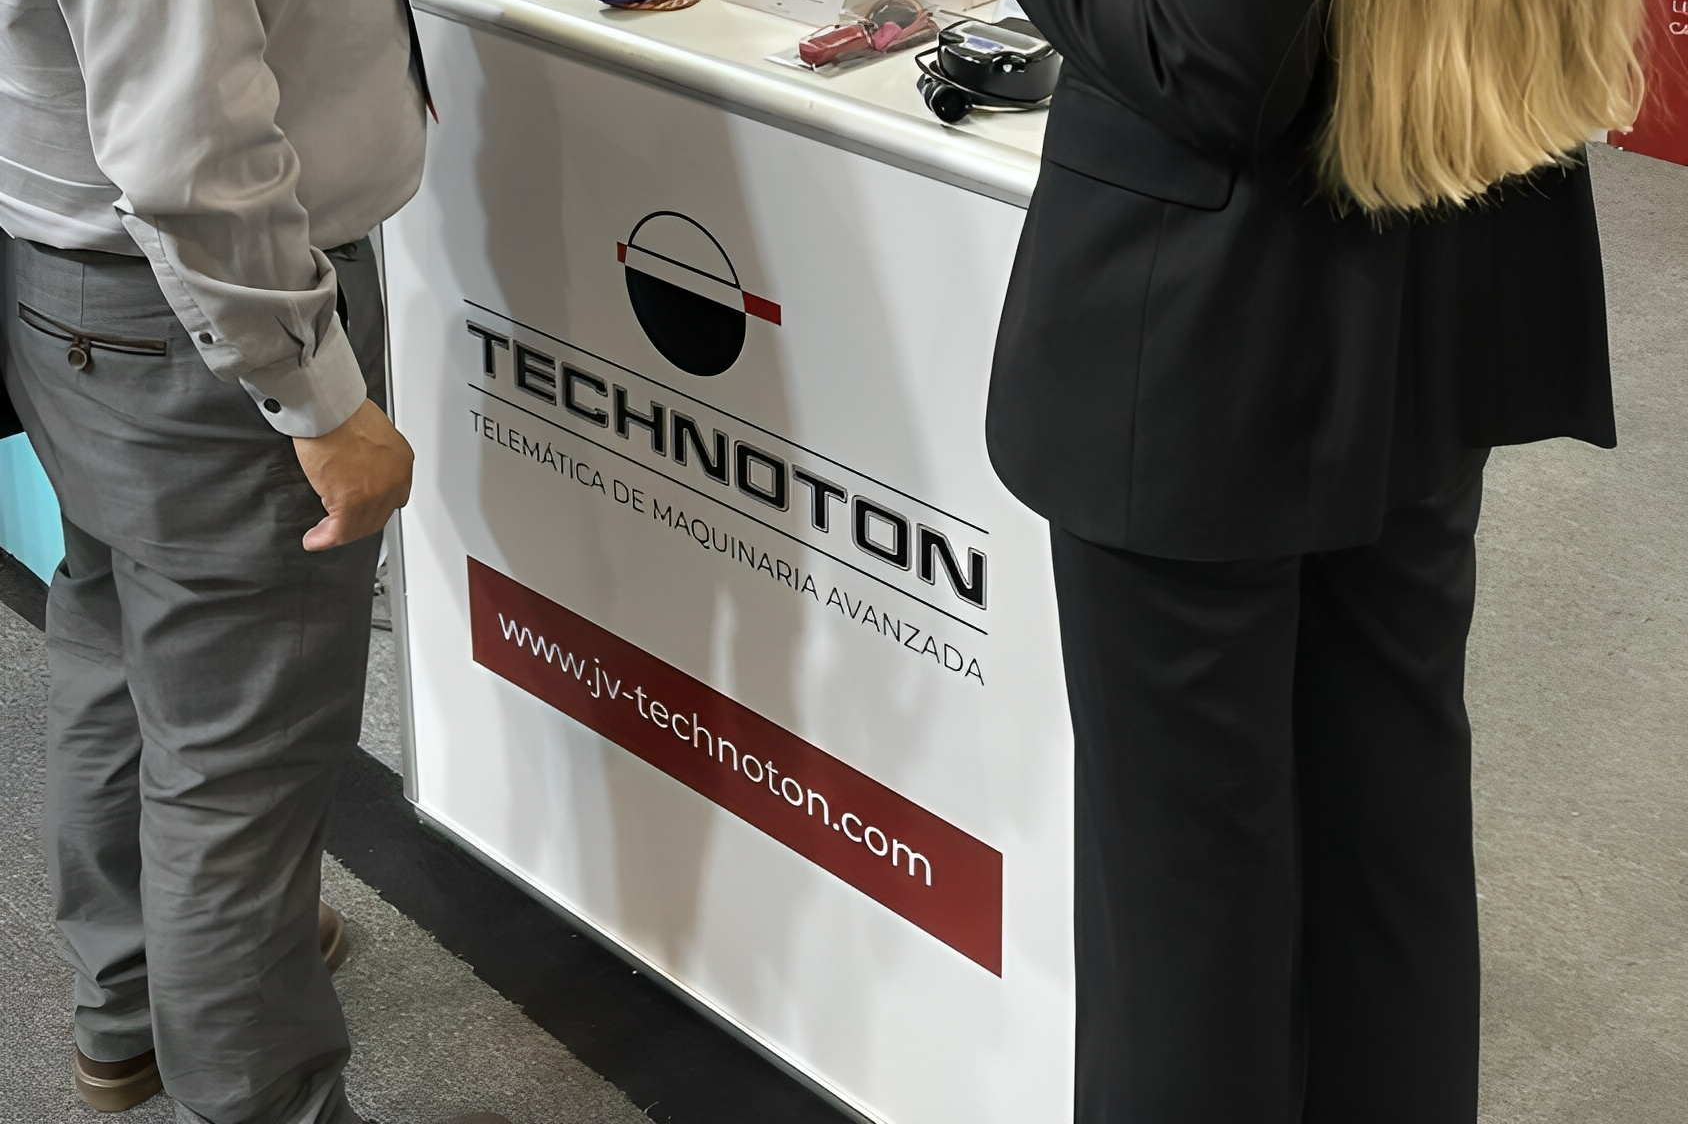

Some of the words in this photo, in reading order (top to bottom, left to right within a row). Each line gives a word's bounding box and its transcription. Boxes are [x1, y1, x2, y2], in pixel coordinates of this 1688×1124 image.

[466, 319, 988, 611] TECHNOTON
[470, 409, 606, 494] TELEMÁTICA
[613, 479, 645, 514] DE
[653, 498, 818, 602] MAQUINARIA
[826, 590, 985, 686] AVANZADA
[498, 612, 932, 887] www.jv-technoton.com
